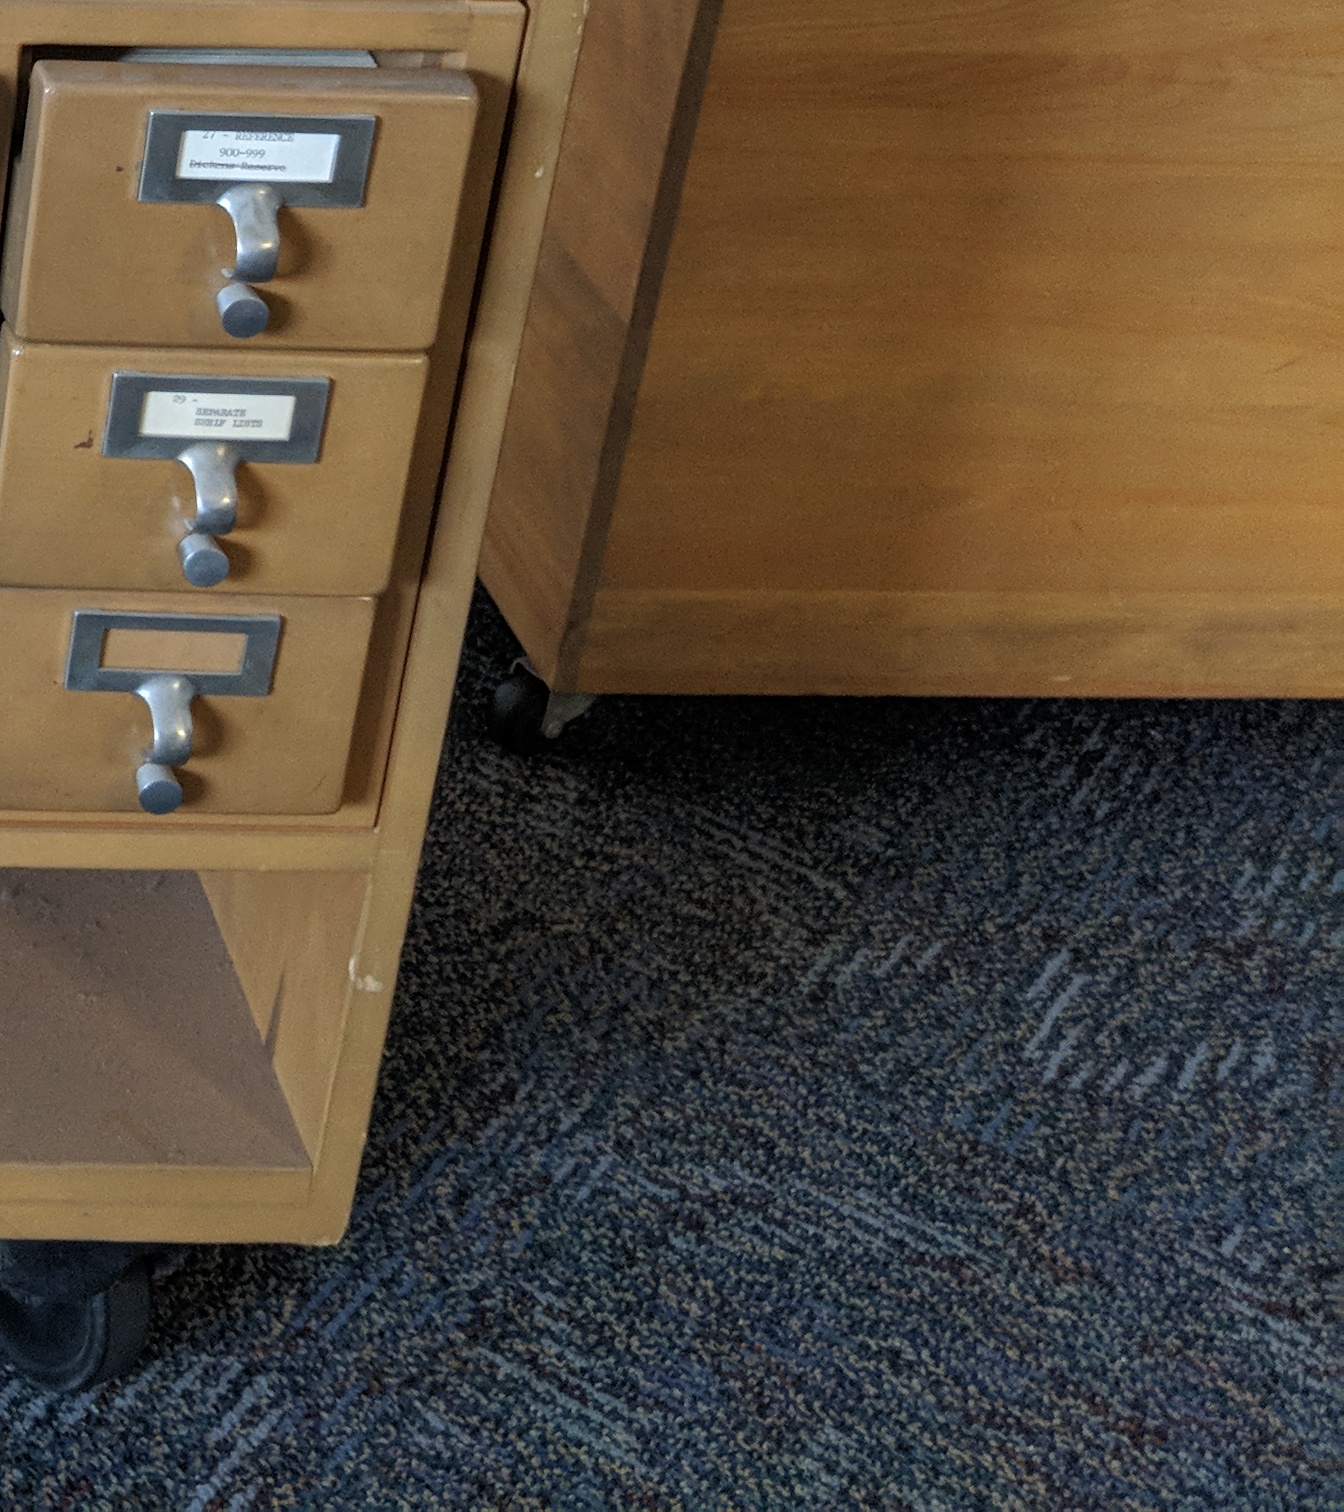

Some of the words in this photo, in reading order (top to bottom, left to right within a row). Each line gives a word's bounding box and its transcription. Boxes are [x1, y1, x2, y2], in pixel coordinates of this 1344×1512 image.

[235, 132, 294, 142] REFERENCE
[220, 148, 265, 158] 900-999
[195, 408, 246, 417] SEPARATE
[194, 419, 226, 427] SHELF
